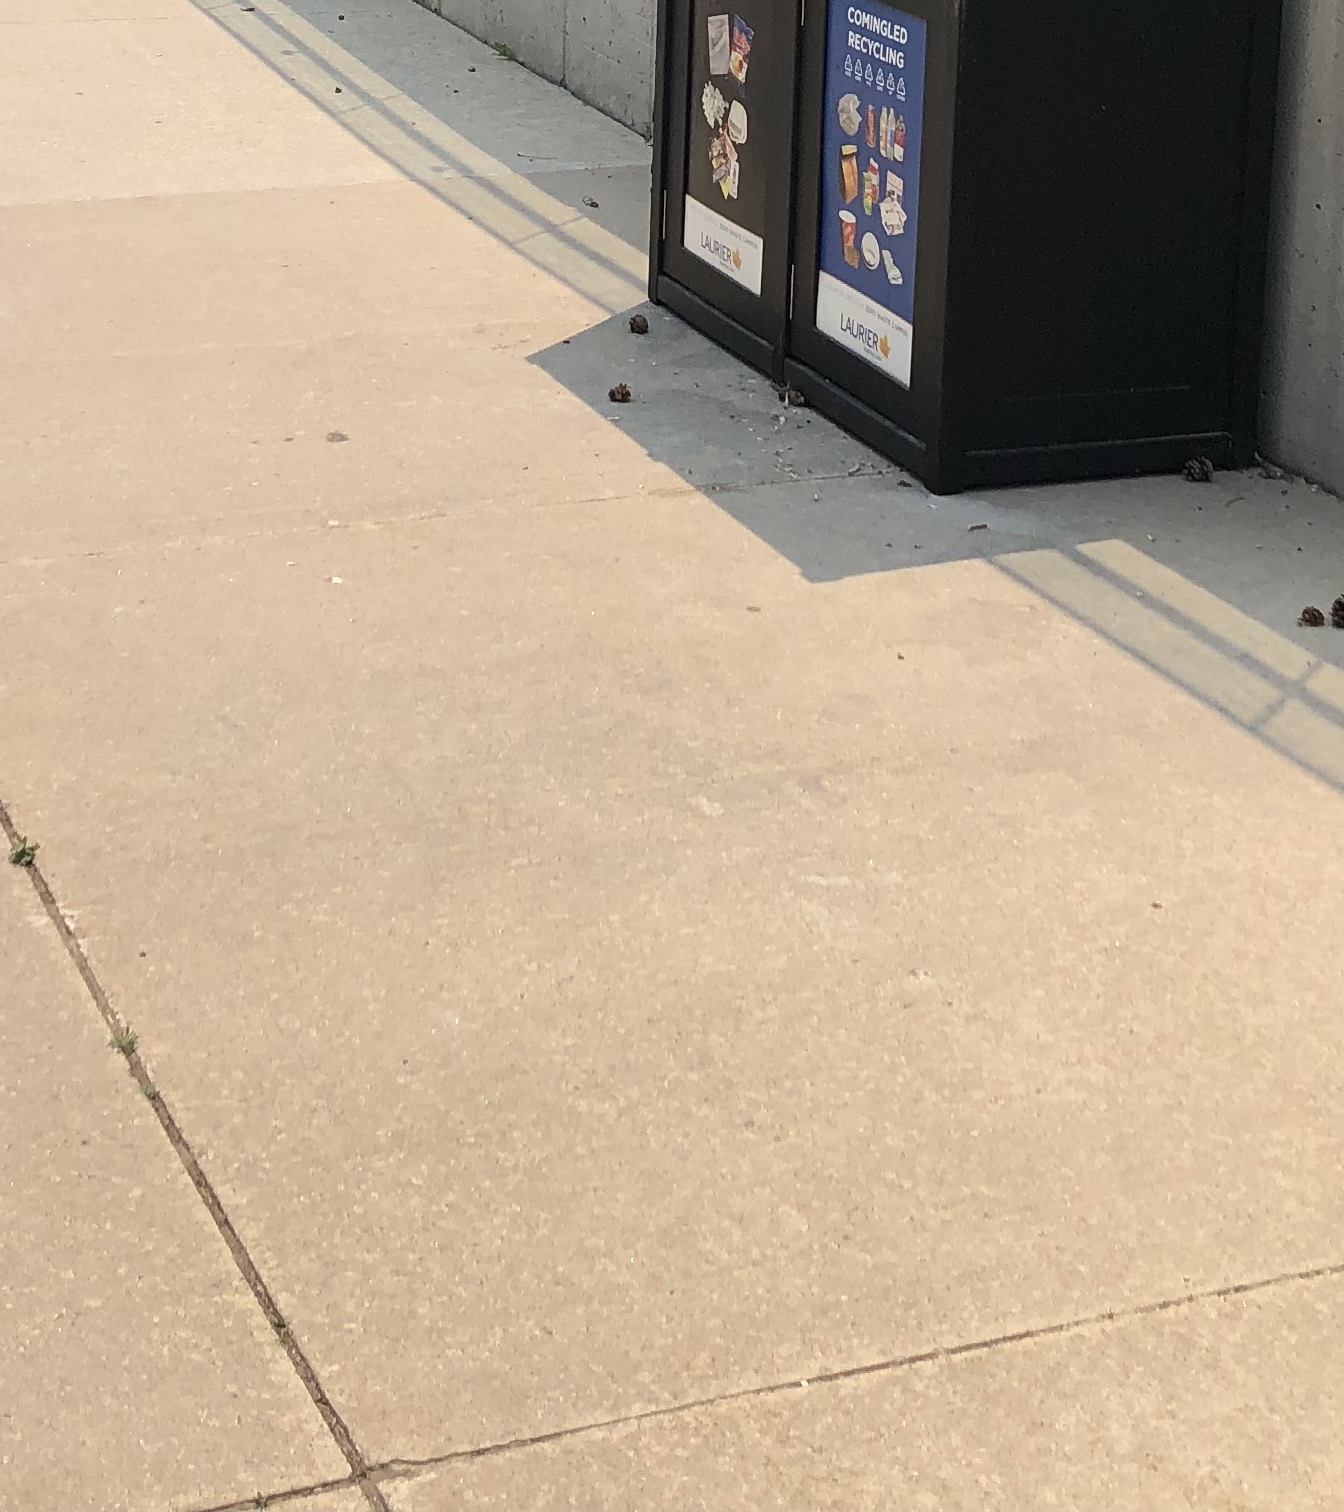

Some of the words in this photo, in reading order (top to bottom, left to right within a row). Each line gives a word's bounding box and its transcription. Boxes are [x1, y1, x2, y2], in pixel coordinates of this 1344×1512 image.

[847, 6, 908, 44] COMINGLED
[848, 30, 905, 69] RECYCLING
[700, 231, 732, 265] LAURIER
[840, 312, 879, 352] LAURIER
